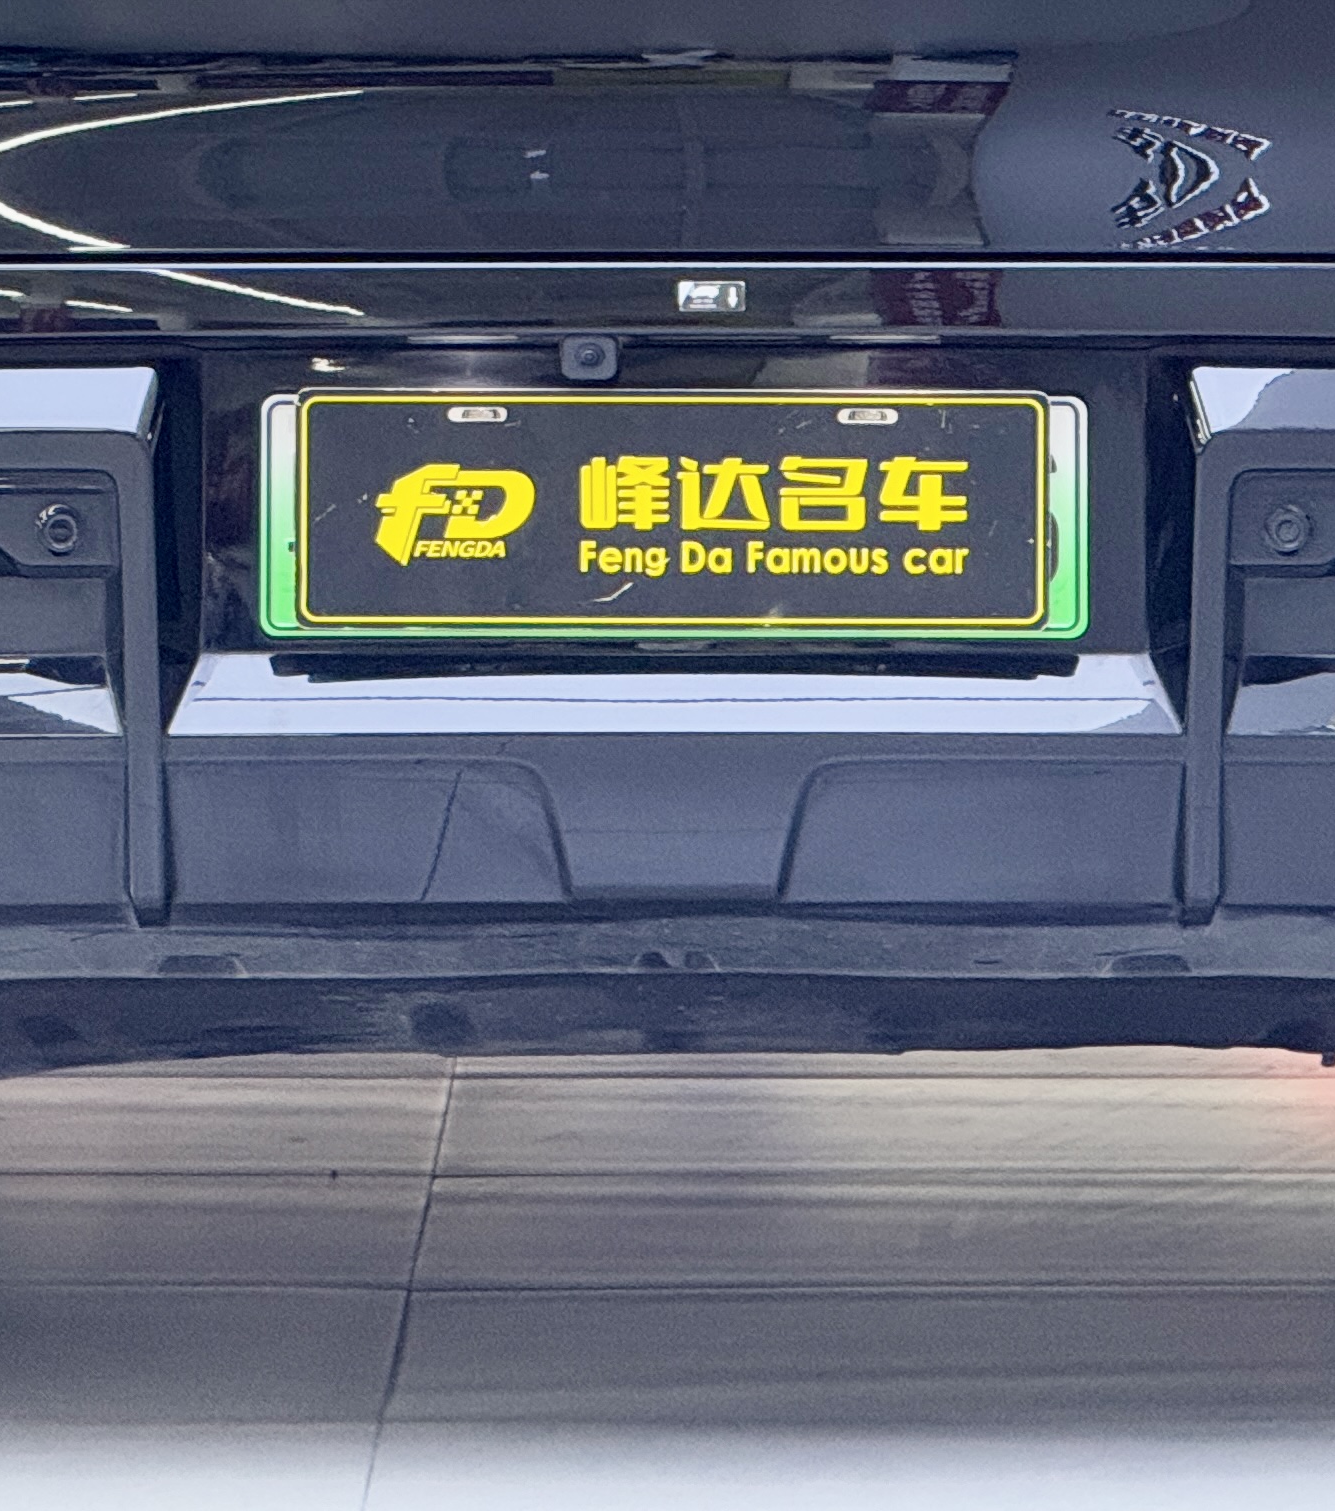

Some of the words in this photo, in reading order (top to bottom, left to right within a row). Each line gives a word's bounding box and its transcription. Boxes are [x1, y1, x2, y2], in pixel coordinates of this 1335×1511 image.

[579, 455, 969, 531] 峰达名车
[413, 540, 507, 558] FENGDA
[579, 540, 668, 577] Feng
[680, 540, 733, 574] Da
[747, 540, 889, 574] Famous
[903, 546, 969, 575] car
